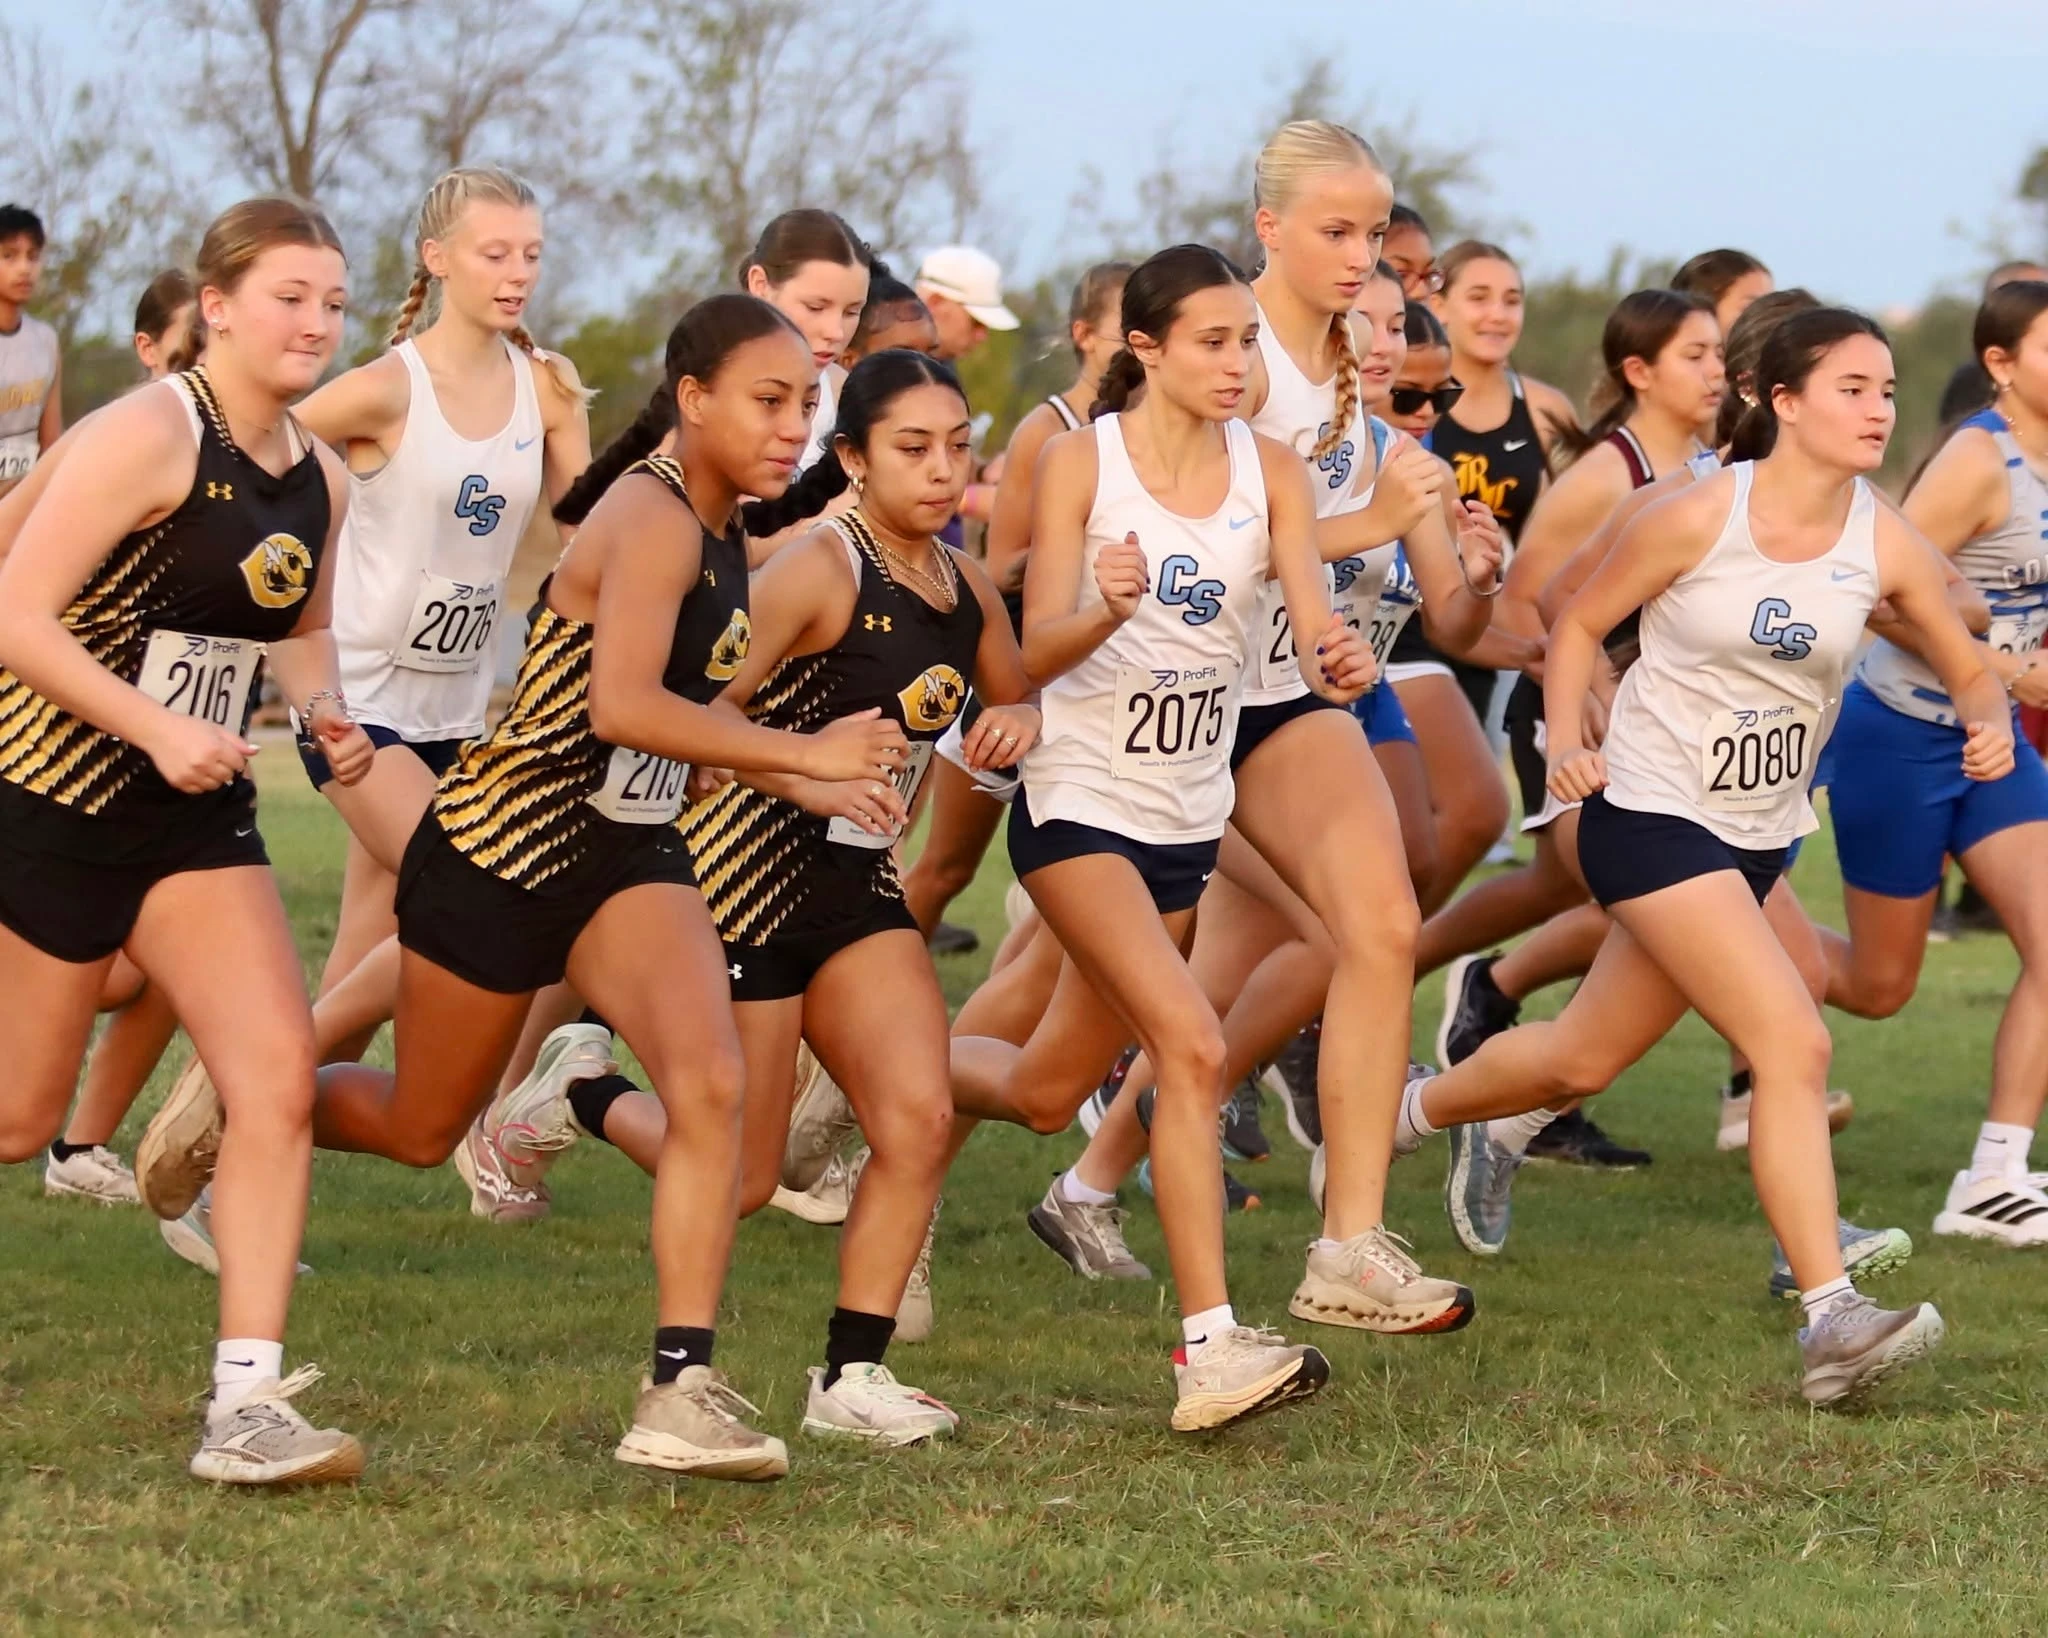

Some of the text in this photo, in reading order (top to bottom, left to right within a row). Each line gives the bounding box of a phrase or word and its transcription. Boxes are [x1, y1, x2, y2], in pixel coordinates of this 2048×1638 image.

[454, 474, 507, 536] CS
[1156, 554, 1226, 626] CS
[1333, 556, 1366, 595] S
[410, 599, 496, 654] 2076
[1749, 597, 1817, 661] CS
[164, 661, 236, 725] 2116
[1184, 667, 1217, 681] ProFit
[1125, 685, 1228, 755] 2075
[1763, 706, 1795, 720] ProFit
[1709, 722, 1807, 792] 2080
